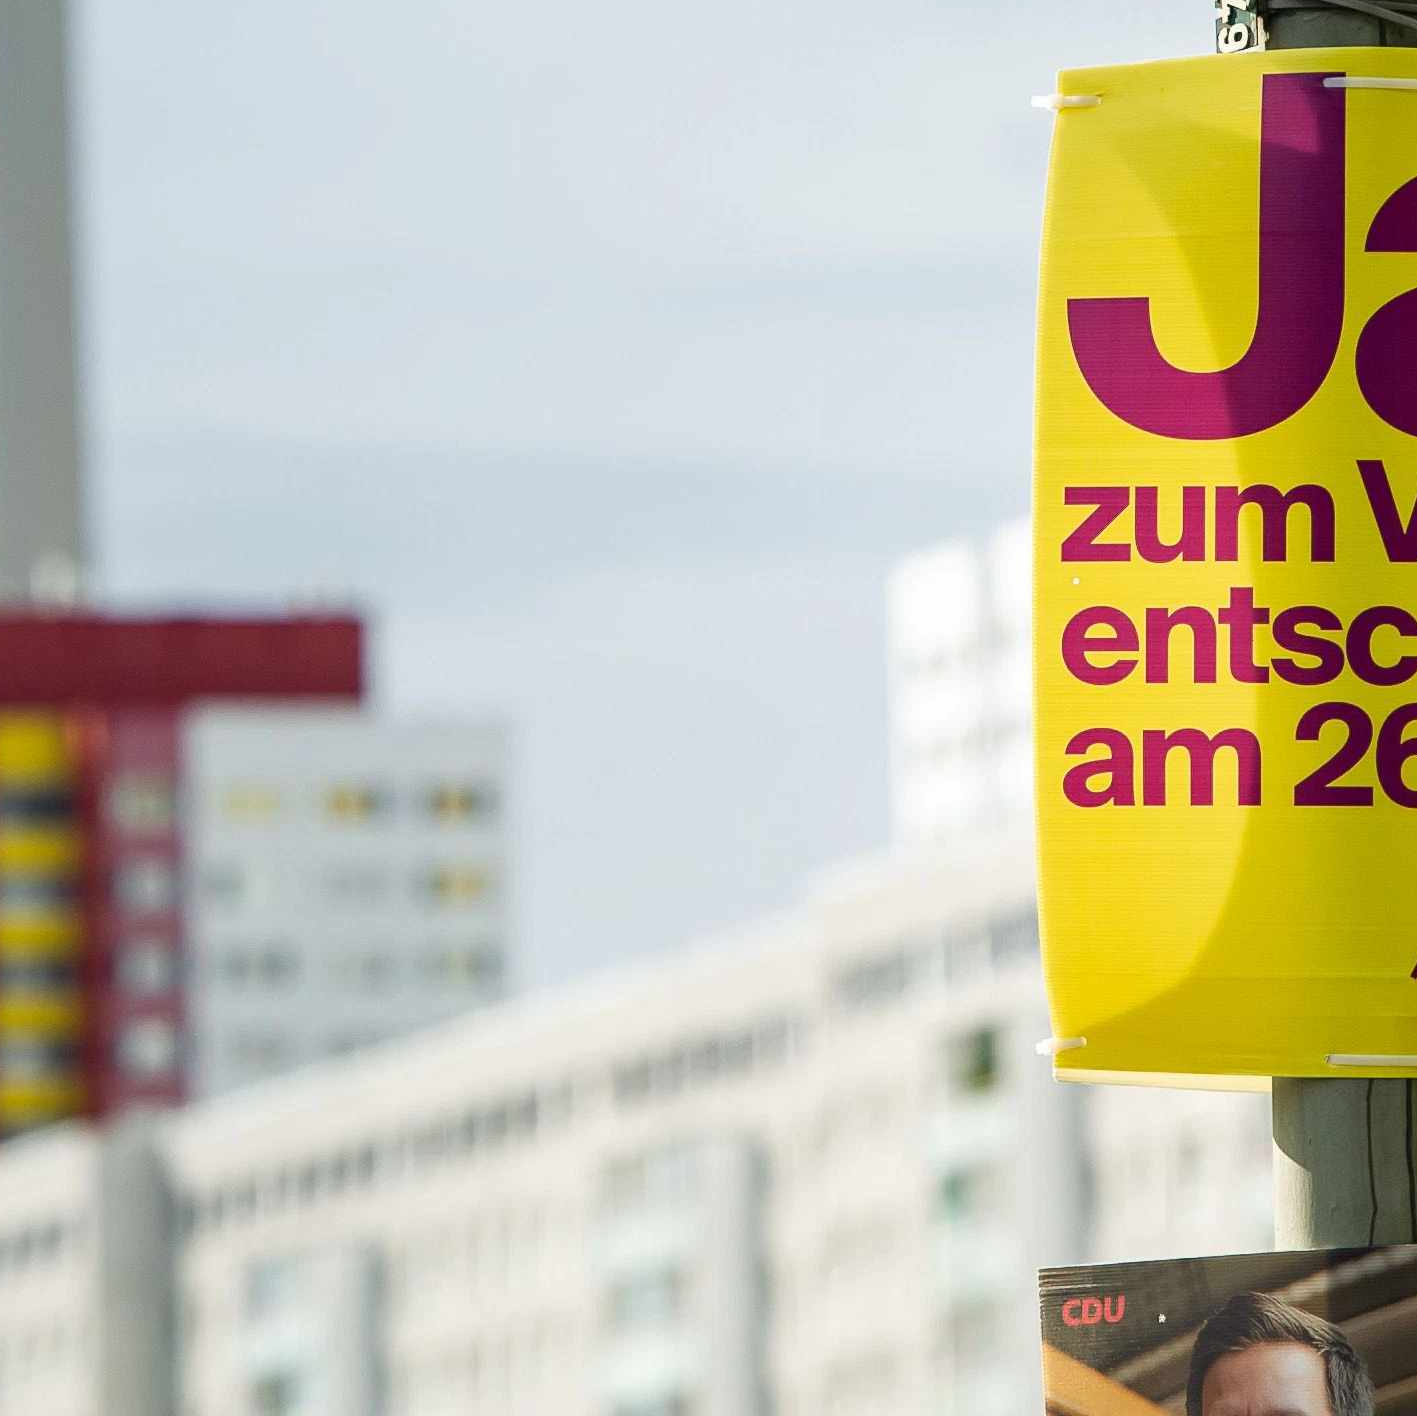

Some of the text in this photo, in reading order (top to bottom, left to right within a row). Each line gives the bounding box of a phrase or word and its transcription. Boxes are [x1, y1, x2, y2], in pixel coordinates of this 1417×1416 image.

[1061, 484, 1335, 563] zum
[1062, 728, 1262, 807] am
[1062, 1296, 1125, 1327] CDU
